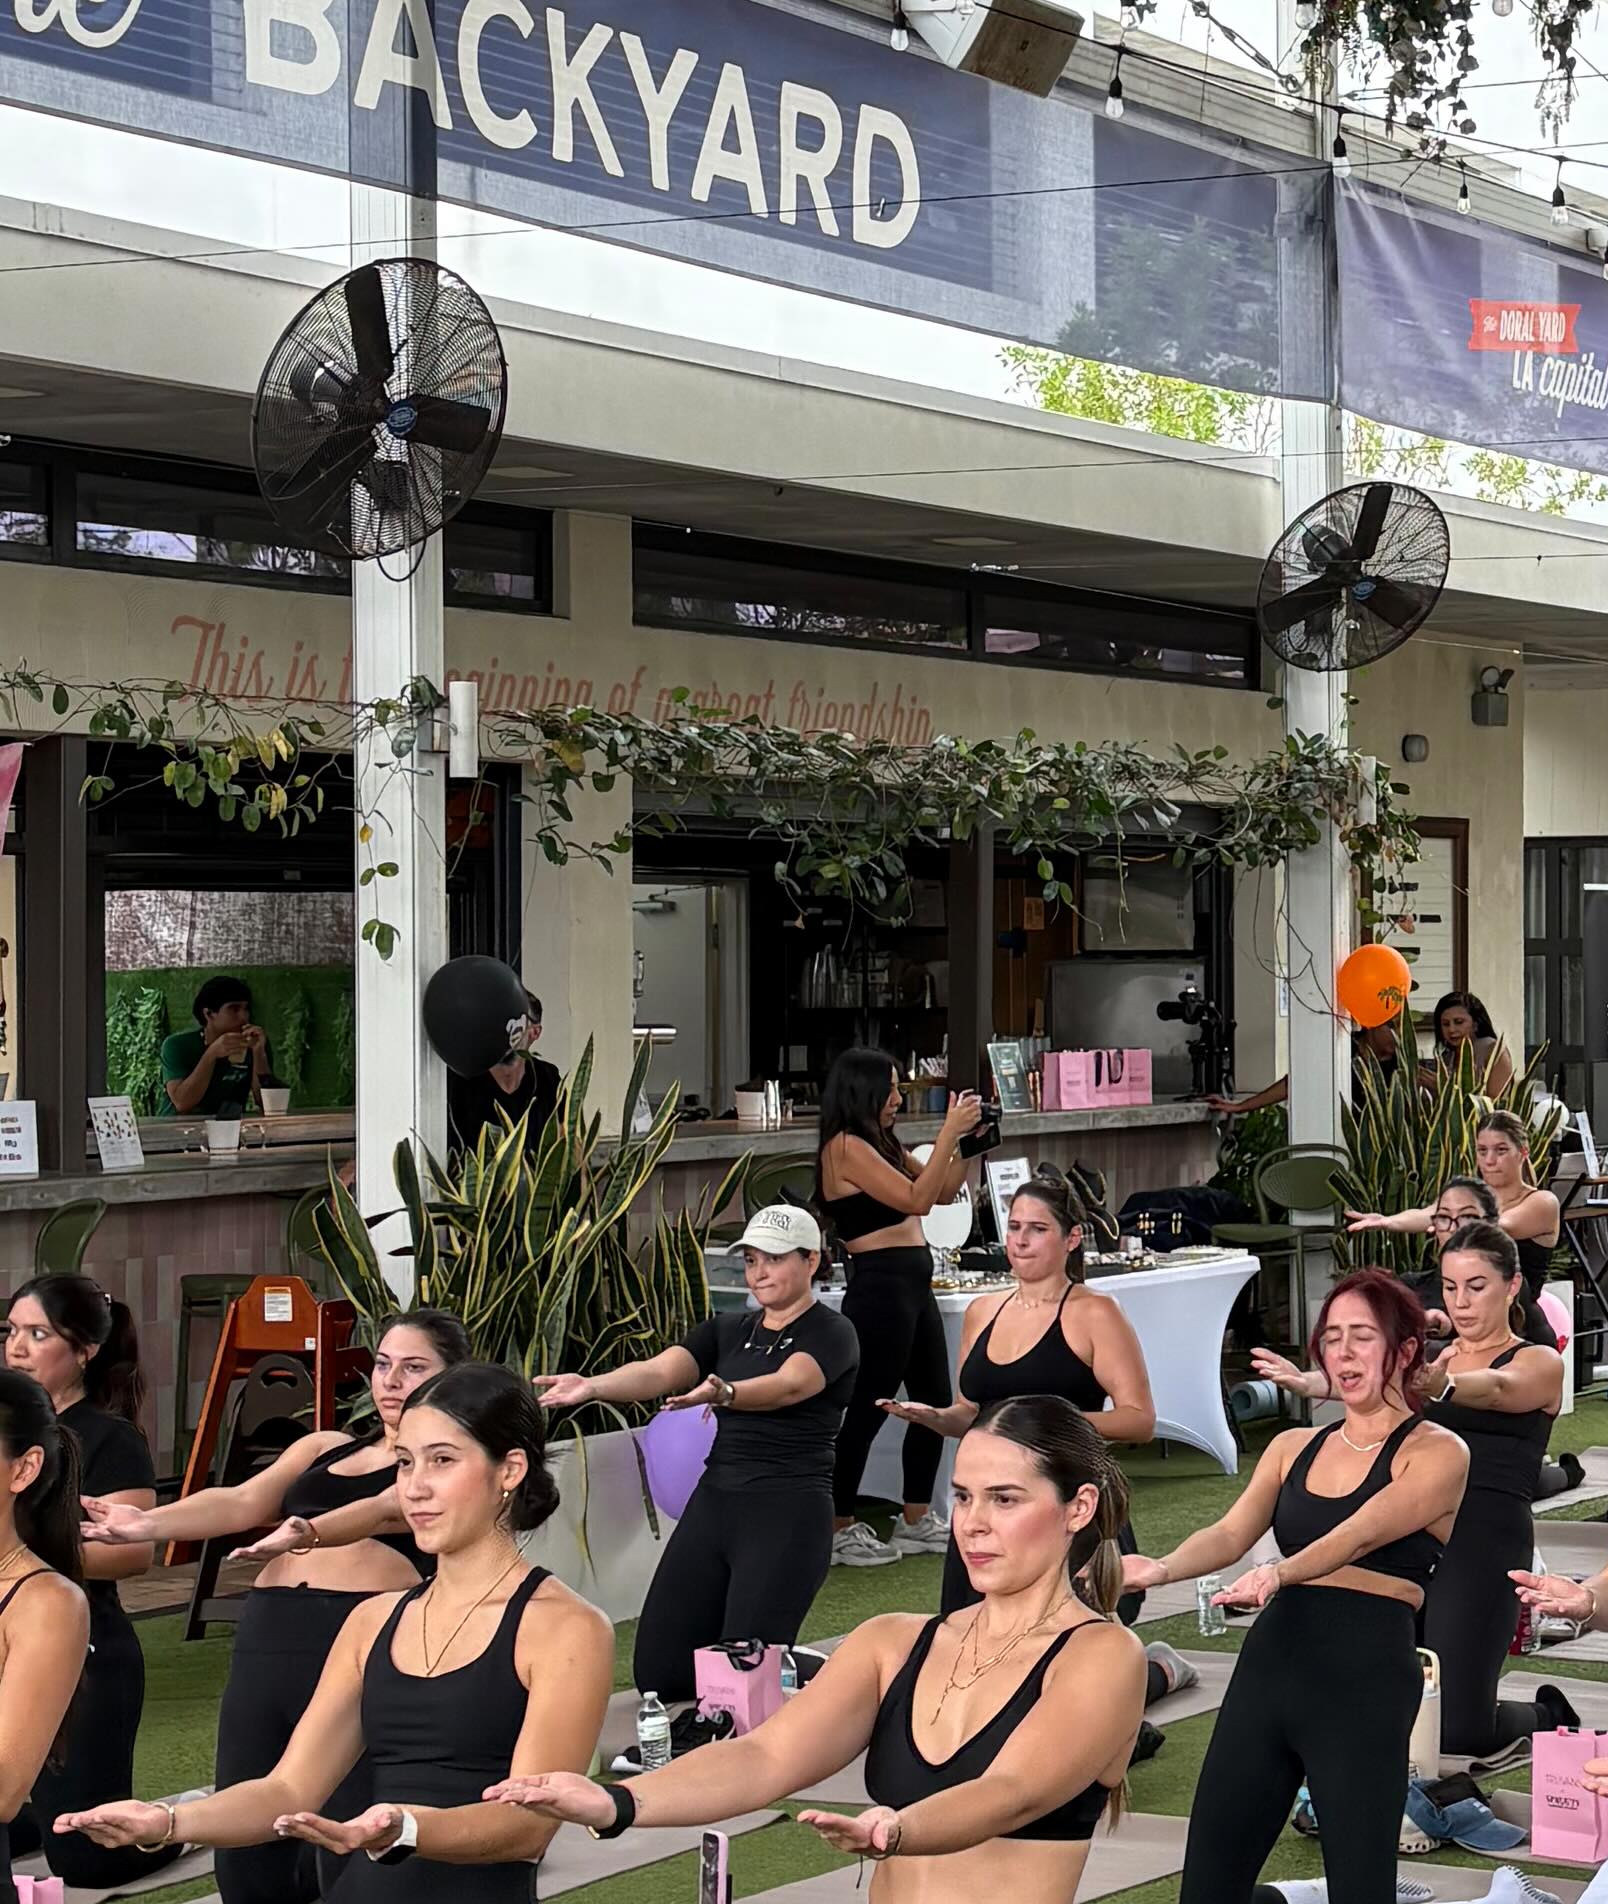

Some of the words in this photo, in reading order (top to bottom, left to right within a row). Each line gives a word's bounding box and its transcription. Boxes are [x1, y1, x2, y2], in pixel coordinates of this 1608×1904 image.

[1499, 309, 1535, 343] DORAL
[1538, 310, 1566, 344] YARD
[1512, 349, 1534, 392] LA
[171, 614, 274, 703] This
[286, 640, 327, 703] is
